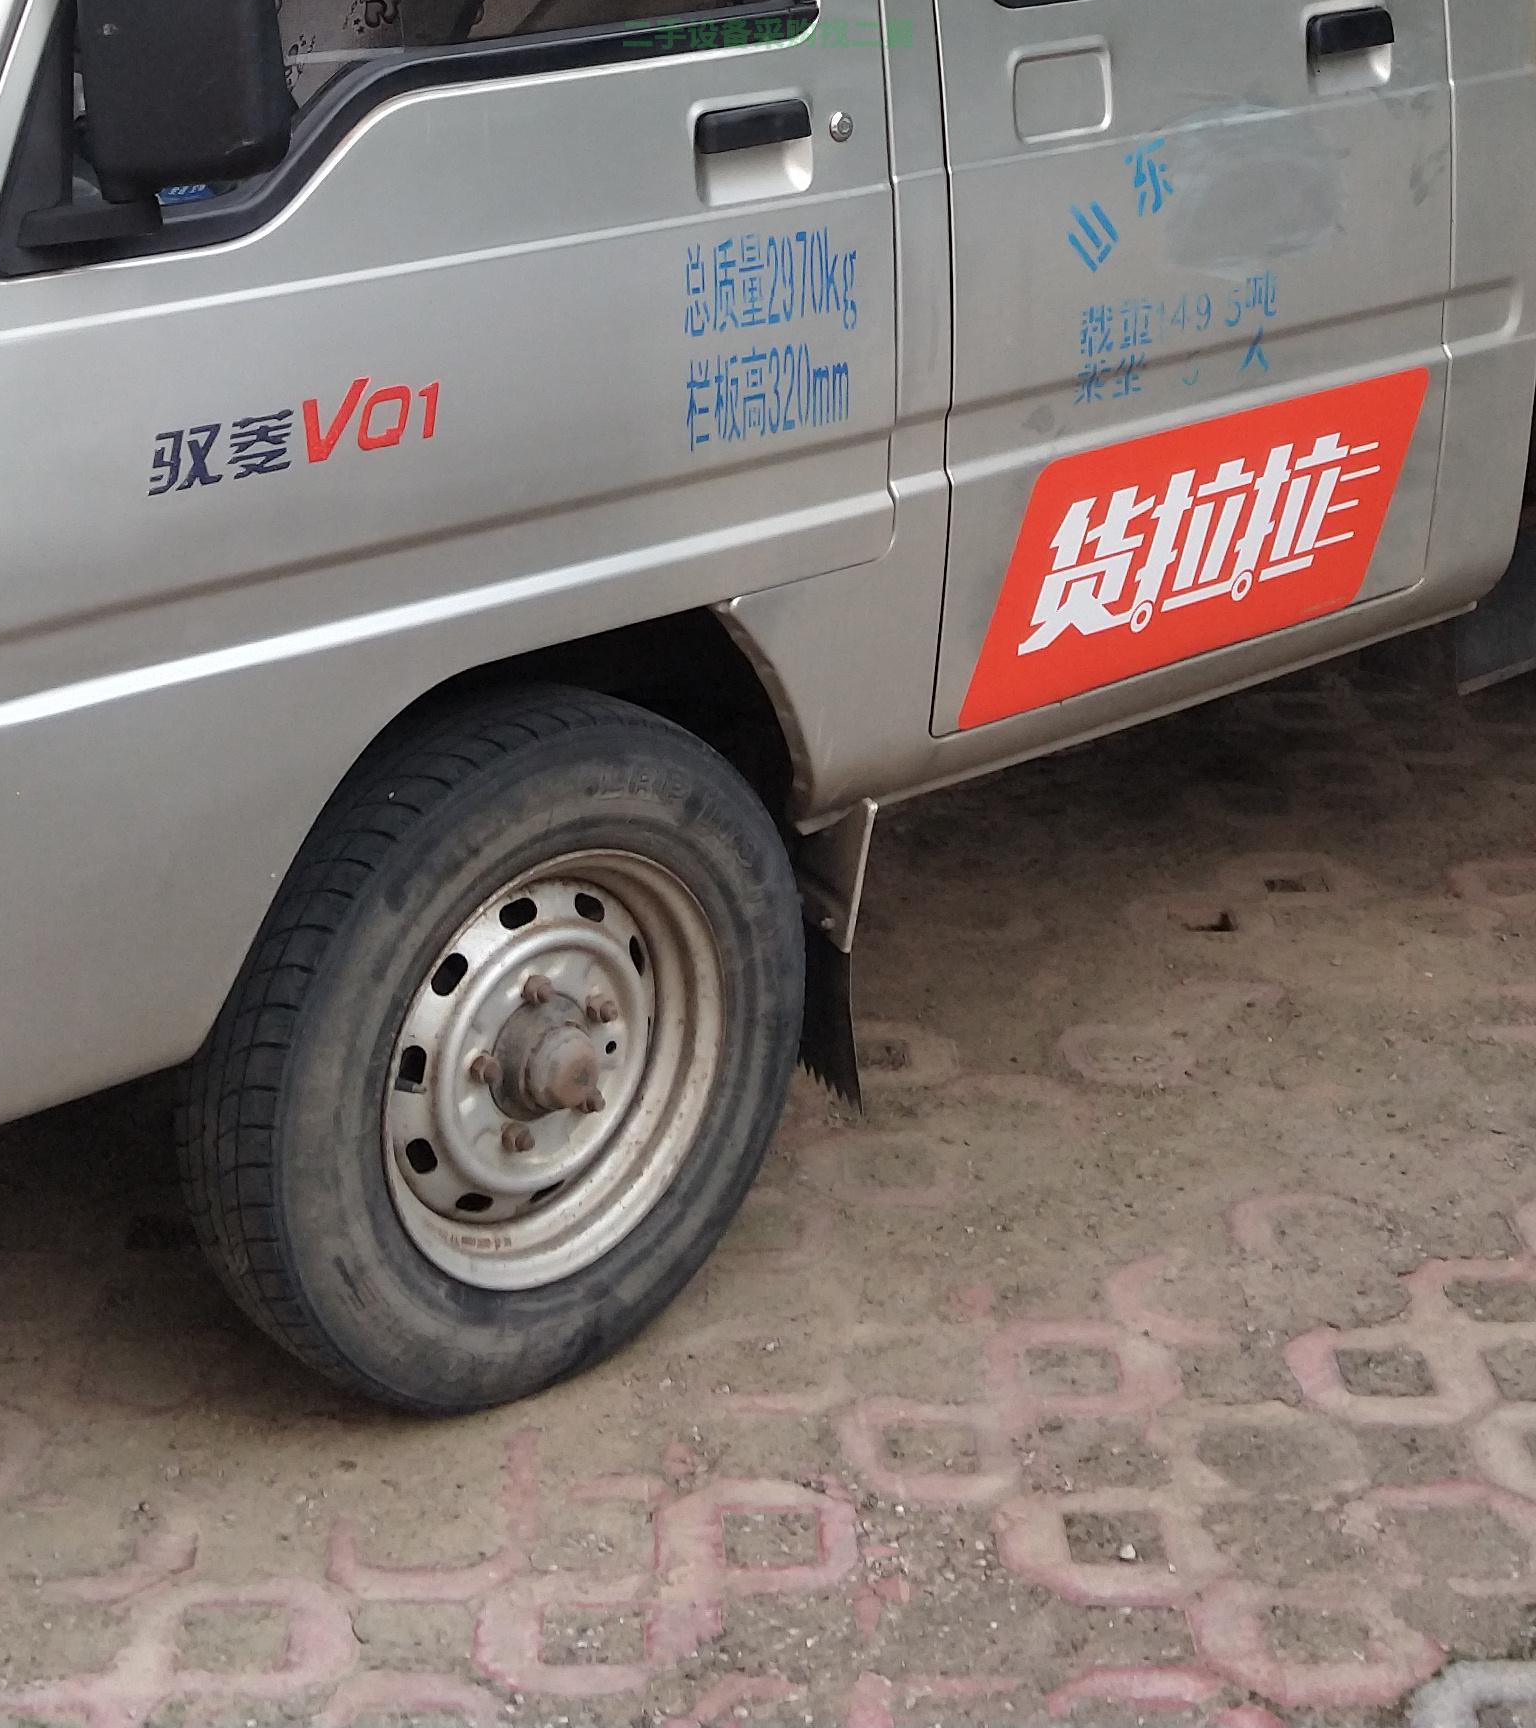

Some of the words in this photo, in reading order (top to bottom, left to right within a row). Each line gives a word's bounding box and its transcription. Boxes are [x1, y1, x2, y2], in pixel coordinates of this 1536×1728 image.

[1067, 138, 1174, 272] 山东
[684, 225, 858, 337] 总质量2970kg
[686, 343, 850, 453] 栏板高320mm
[1017, 432, 1364, 657] 货拉拉
